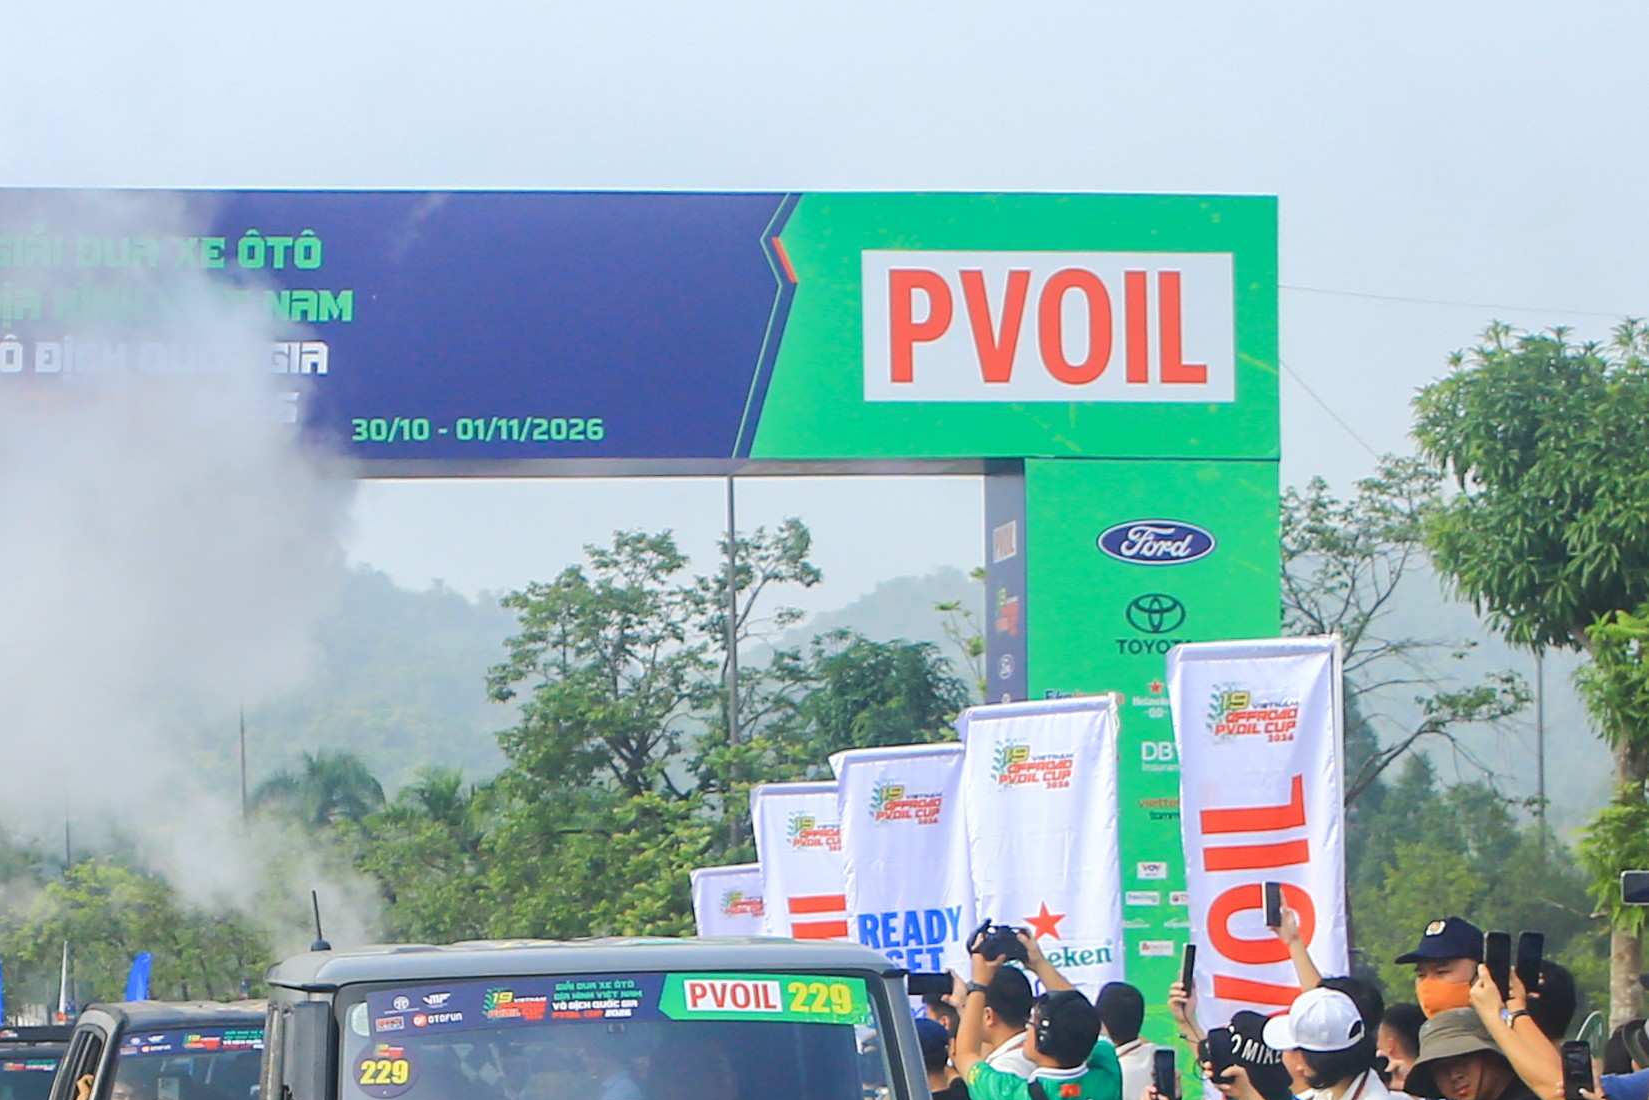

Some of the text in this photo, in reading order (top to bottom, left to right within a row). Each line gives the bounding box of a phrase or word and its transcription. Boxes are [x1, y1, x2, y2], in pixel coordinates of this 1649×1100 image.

[172, 235, 226, 269] XE
[237, 227, 323, 271] ÔTÔ
[270, 288, 354, 323] NAM
[887, 267, 1209, 386] PVOIL
[267, 341, 330, 376] GIA
[351, 417, 605, 443] 30/10 - 01/11/2026
[1119, 524, 1195, 559] Ford
[1116, 638, 1193, 656] TOYO
[1220, 691, 1250, 711] 19
[1214, 720, 1297, 736] PVOIL CUP
[1003, 745, 1030, 763] 19
[998, 770, 1071, 785] PVOIL CUP
[876, 807, 940, 821] PVOIL CUP
[1199, 774, 1316, 1018] VOIL
[857, 904, 964, 950] READY
[688, 981, 853, 1014] PVOIL 229
[427, 1012, 463, 1024] OTOFUN
[360, 1058, 411, 1086] 229
